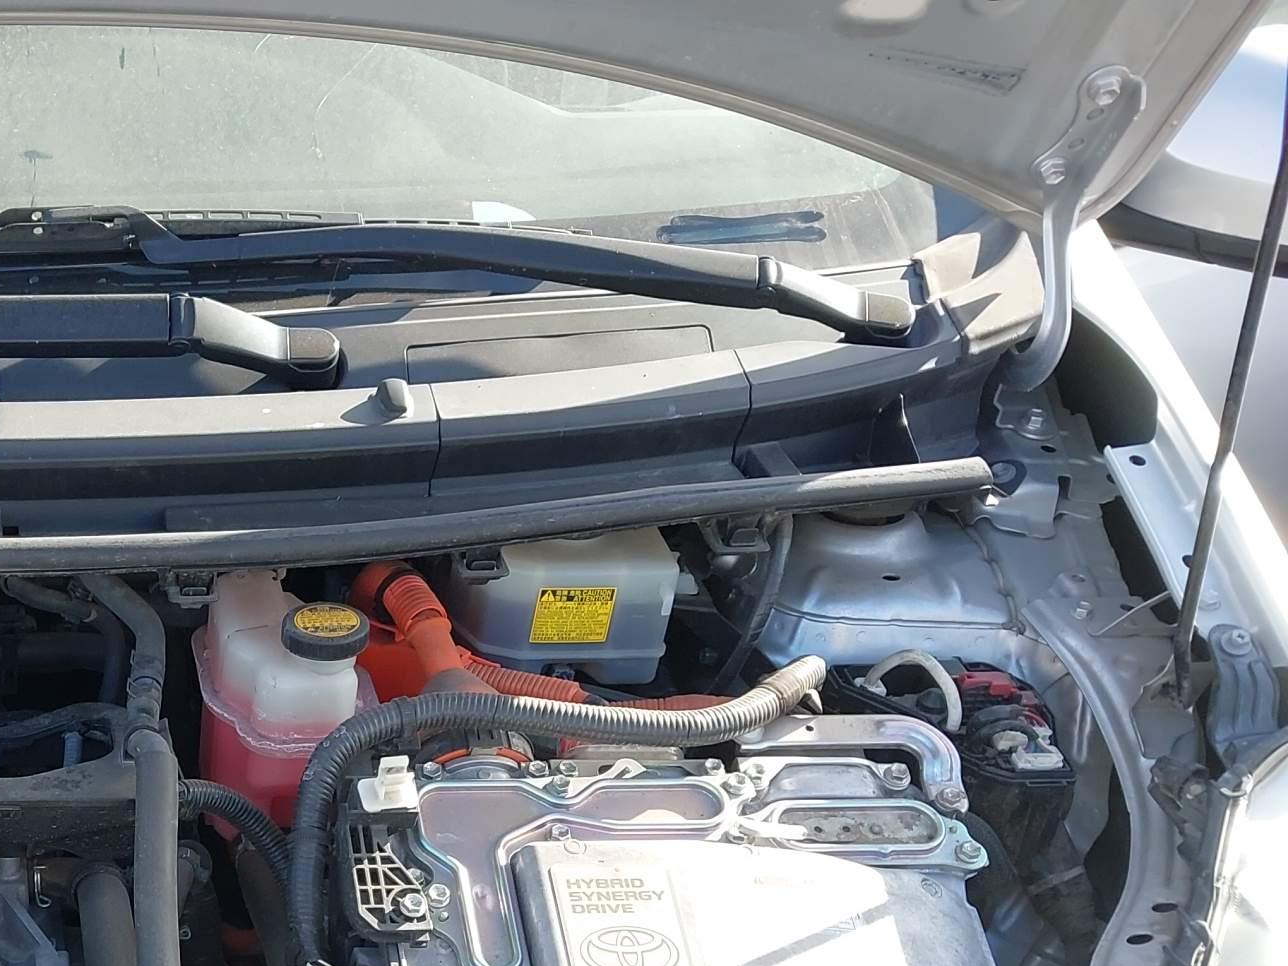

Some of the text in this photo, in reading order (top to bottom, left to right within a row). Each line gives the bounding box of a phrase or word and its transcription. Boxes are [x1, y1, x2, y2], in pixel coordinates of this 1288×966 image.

[566, 878, 645, 889] HYBRID
[568, 890, 665, 902] SYNERGY
[571, 903, 636, 914] DRIVE
